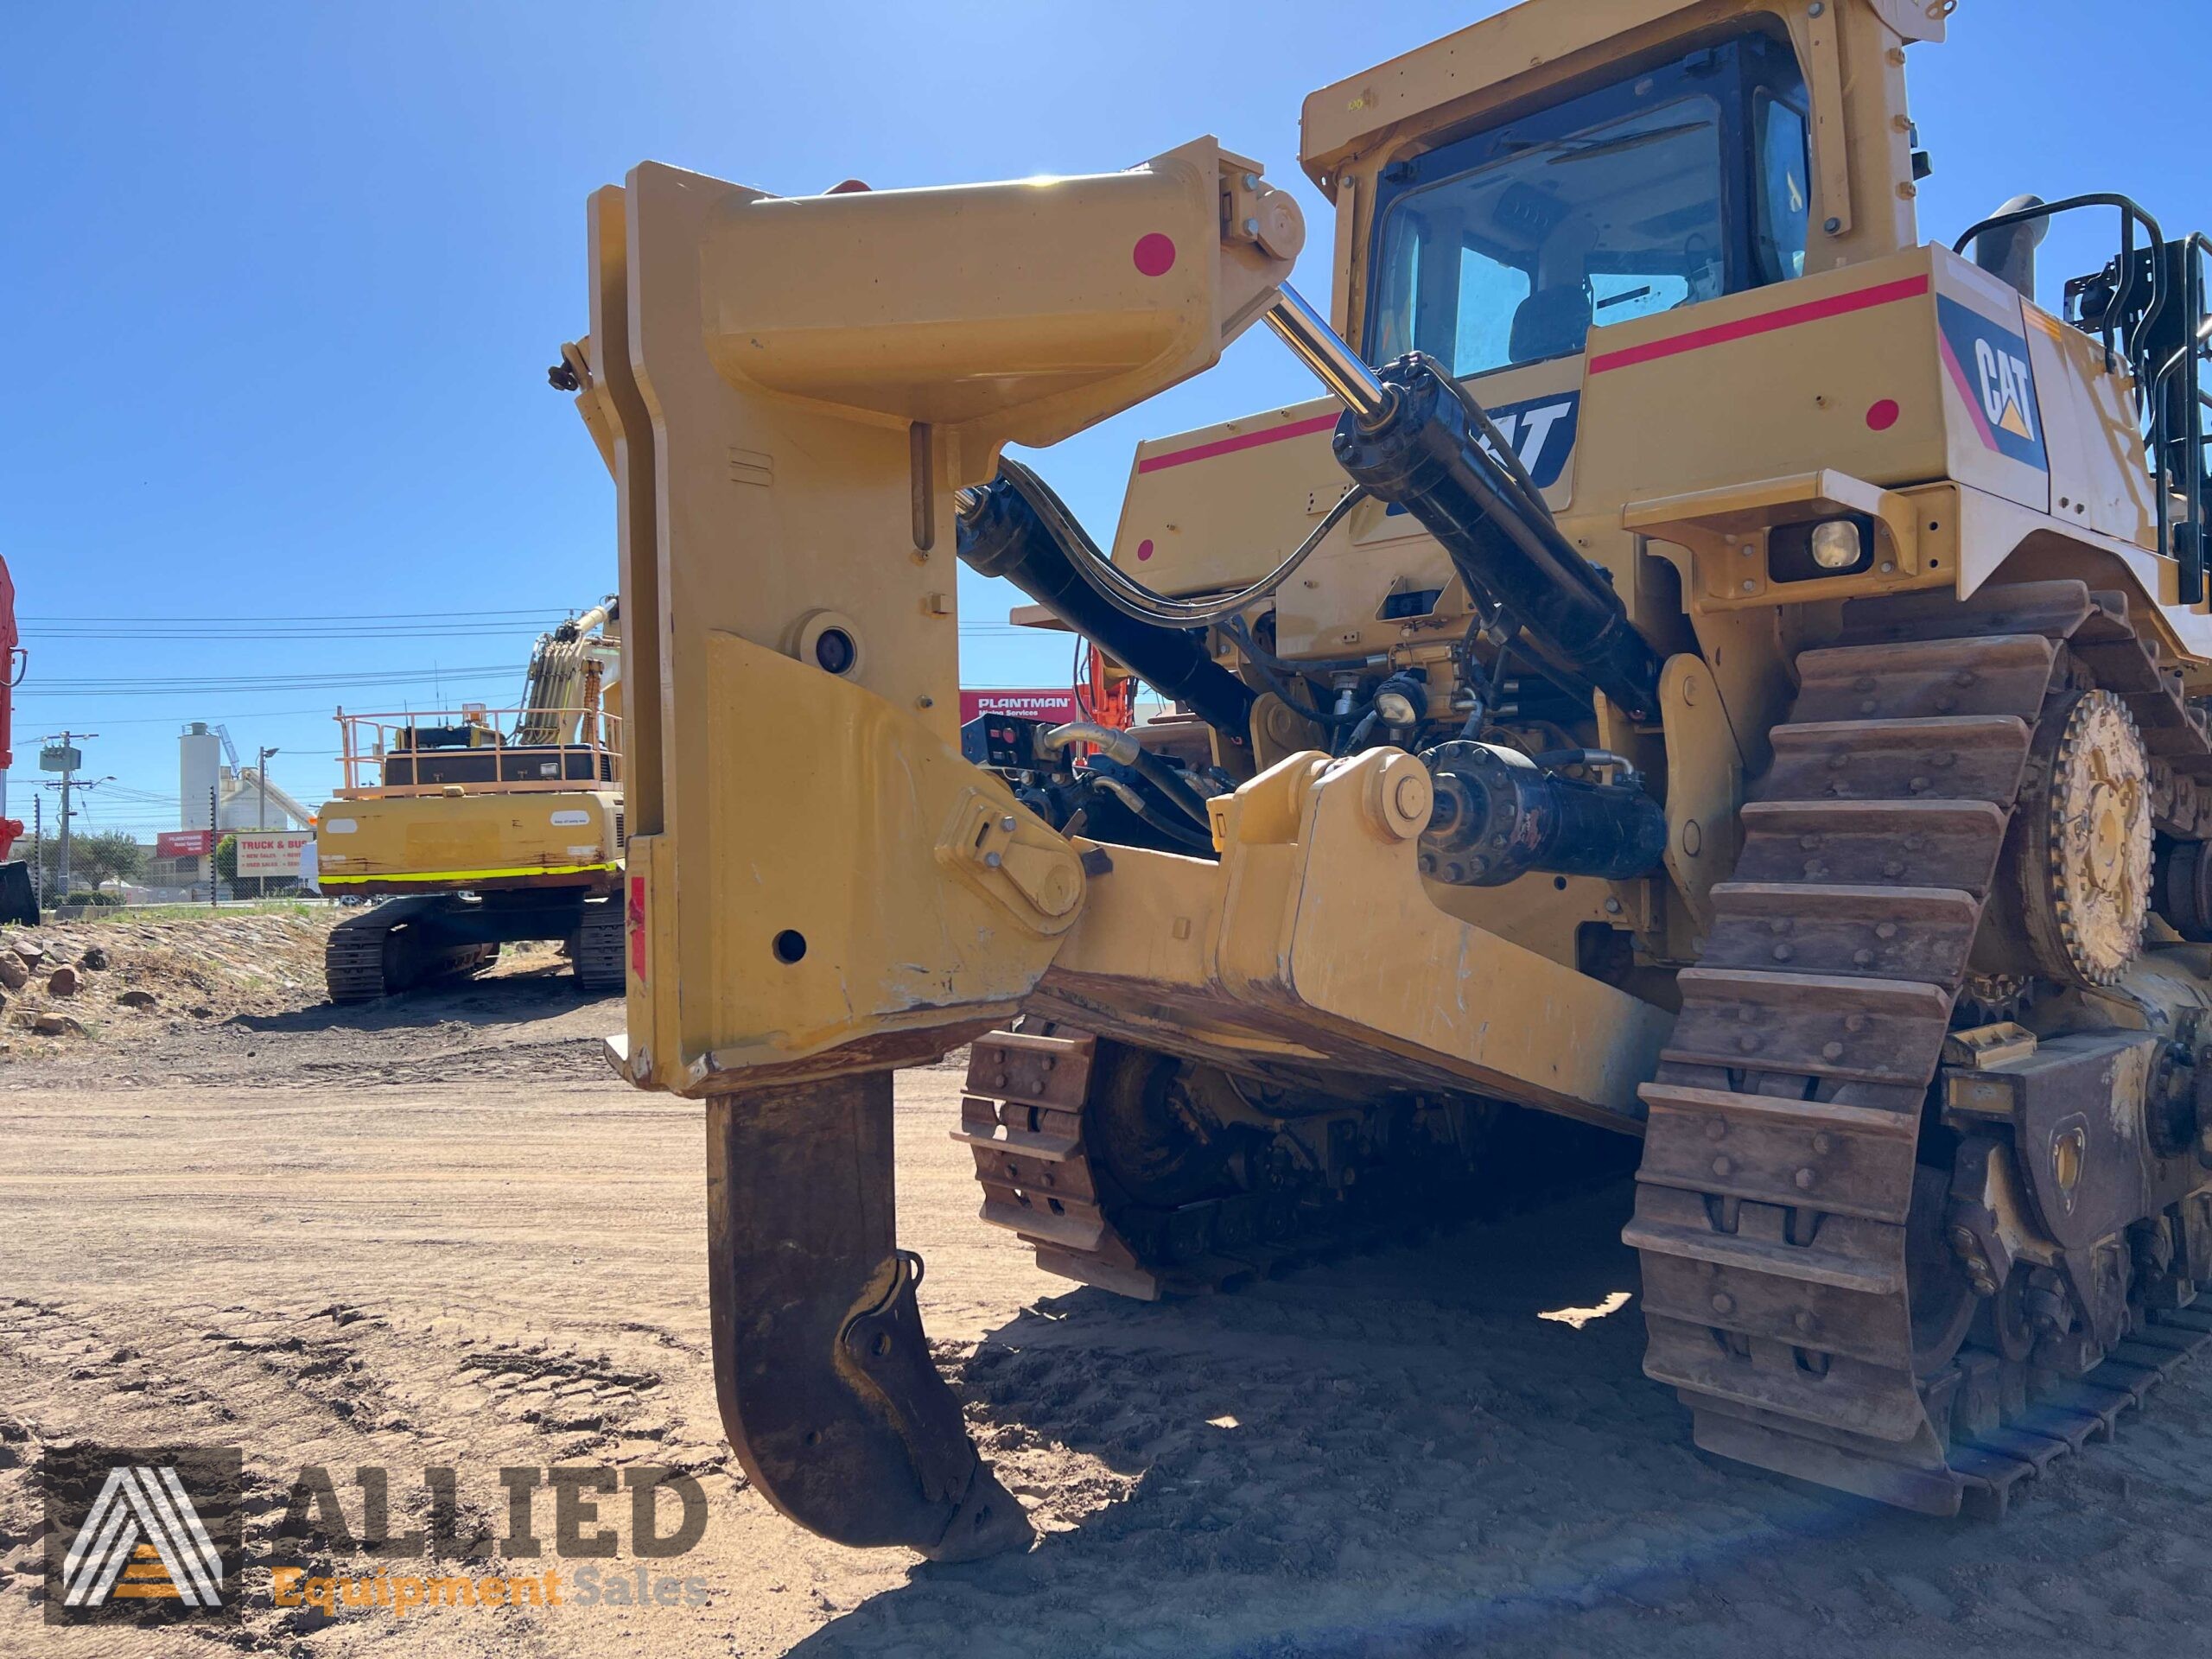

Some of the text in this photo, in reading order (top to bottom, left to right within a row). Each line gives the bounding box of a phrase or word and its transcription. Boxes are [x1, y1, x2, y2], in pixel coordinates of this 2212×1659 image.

[1975, 338, 2035, 442] CAT
[1477, 402, 1572, 476] AT
[978, 697, 1068, 709] PLANTMAN
[241, 841, 274, 850] TRUCK
[276, 840, 284, 849] &
